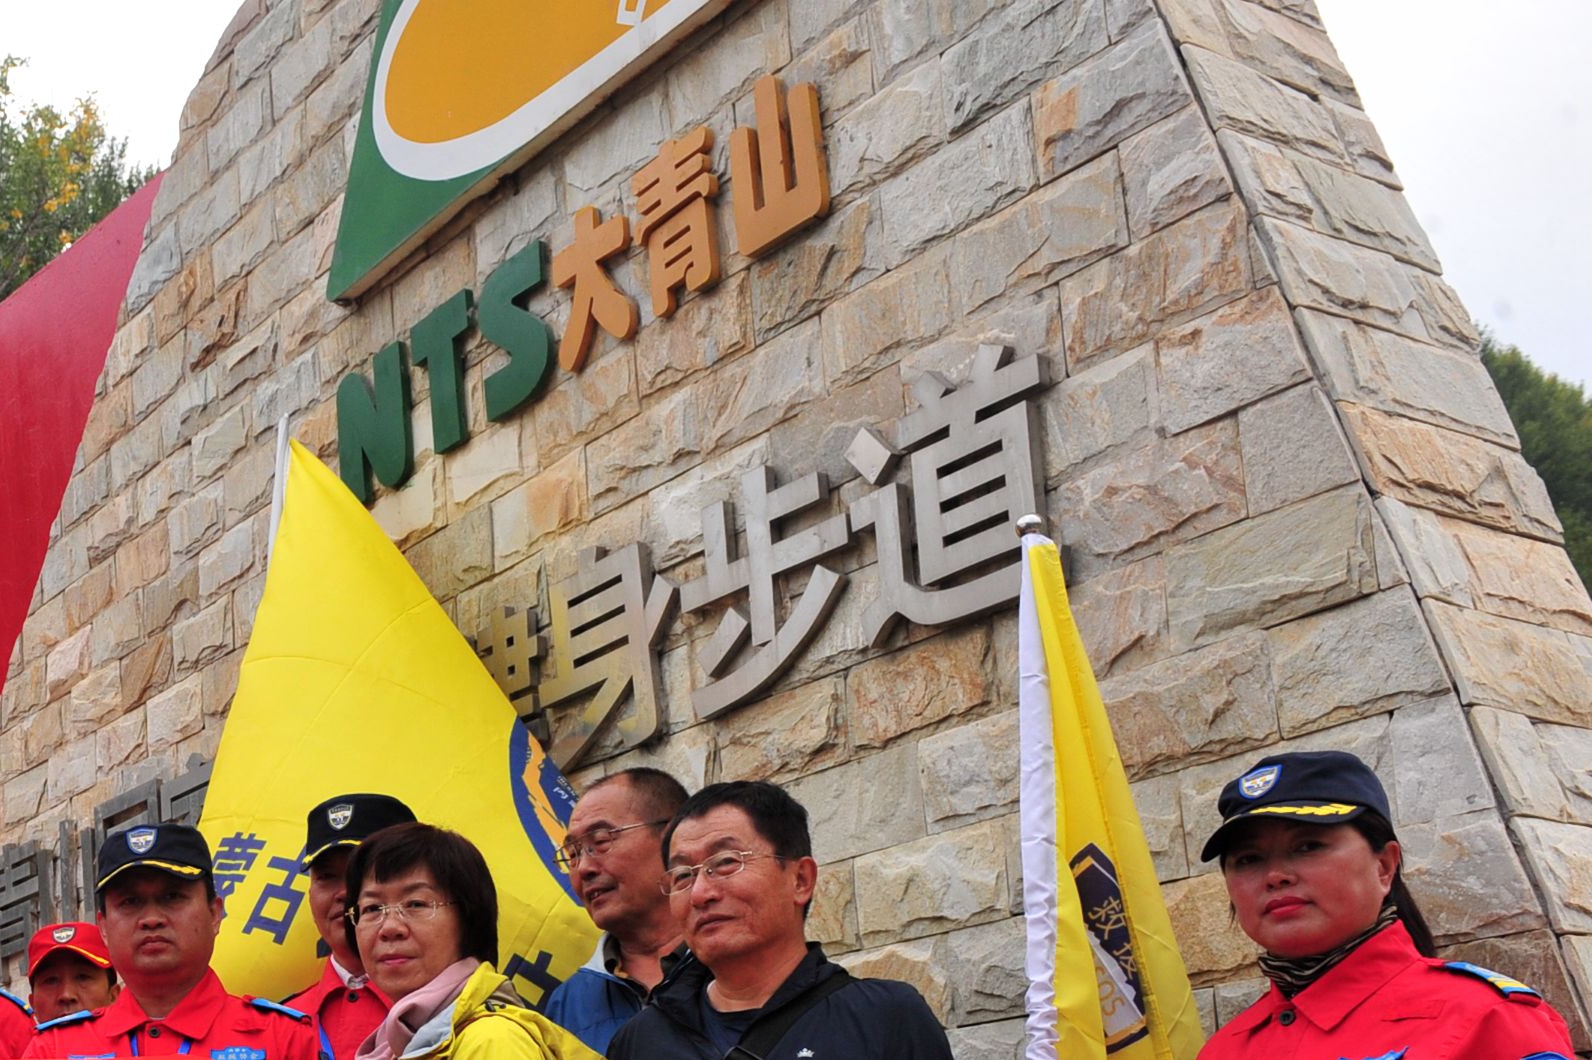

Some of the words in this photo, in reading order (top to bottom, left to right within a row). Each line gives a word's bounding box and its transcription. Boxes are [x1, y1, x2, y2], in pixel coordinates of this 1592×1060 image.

[335, 240, 553, 503] NTS
[551, 74, 831, 373] 大青山
